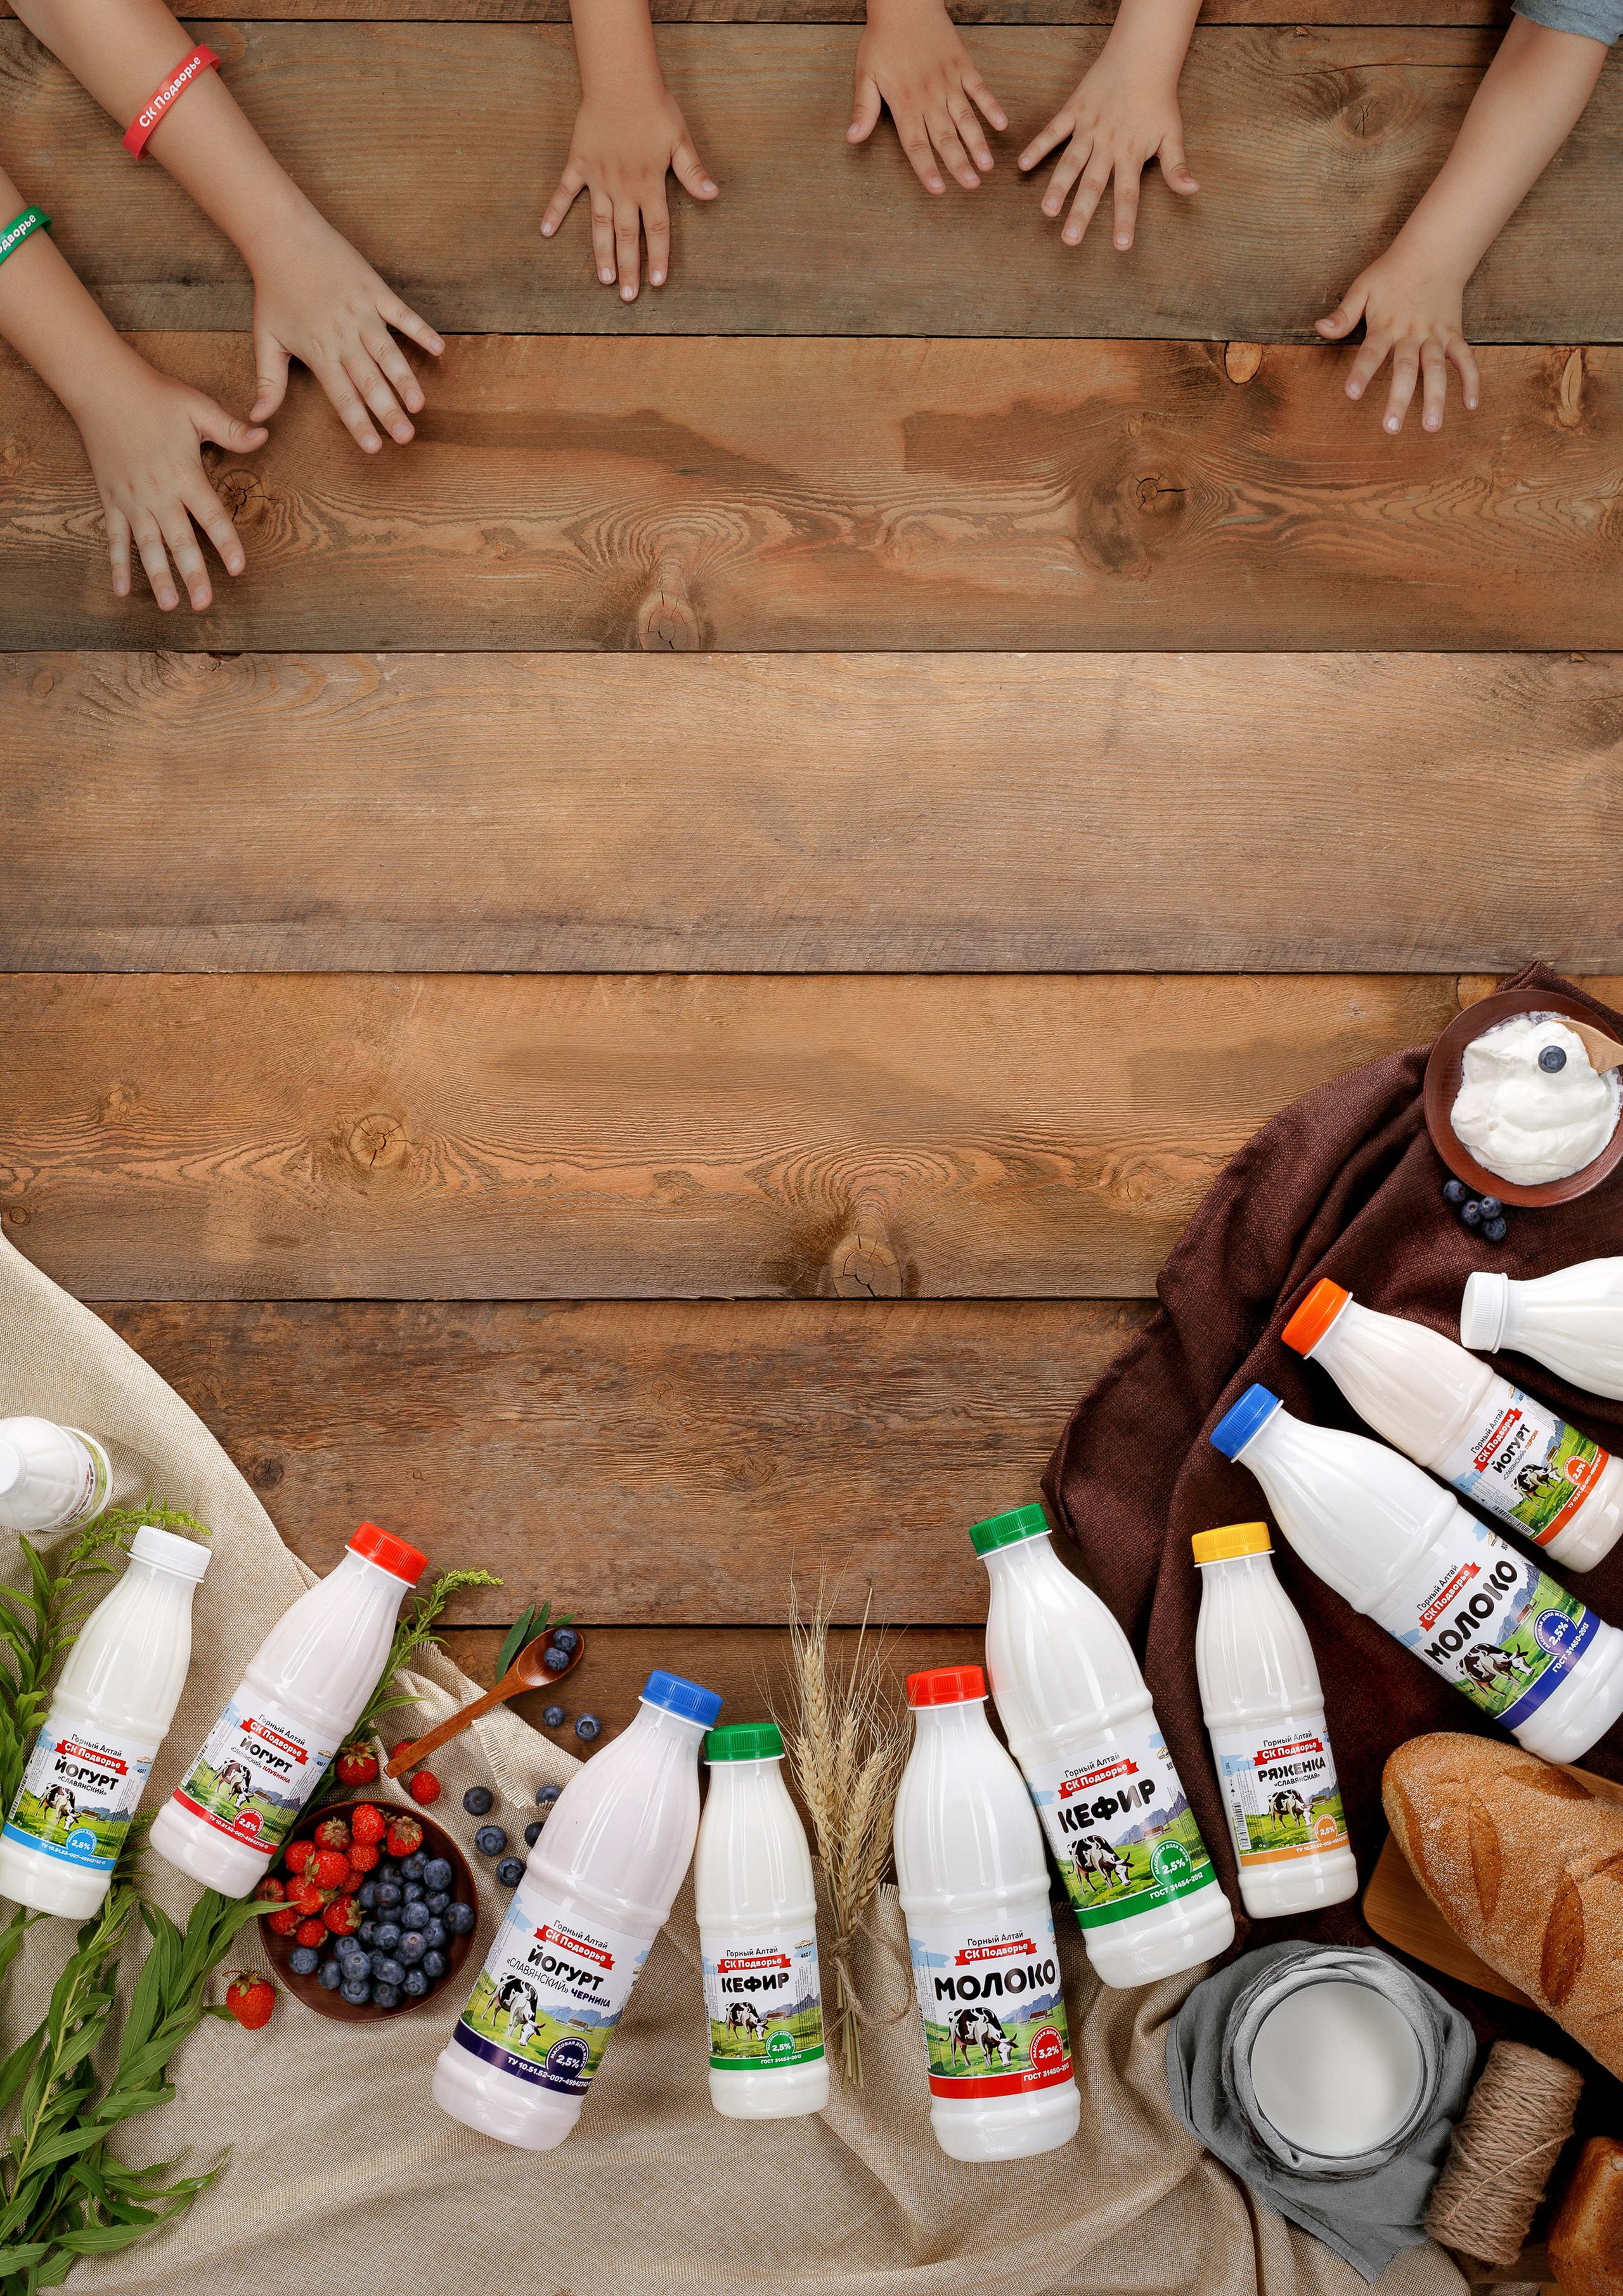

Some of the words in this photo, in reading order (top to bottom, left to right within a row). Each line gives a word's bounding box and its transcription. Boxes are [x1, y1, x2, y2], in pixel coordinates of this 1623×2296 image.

[139, 107, 157, 127] СК
[154, 57, 200, 109] Подворье
[1471, 1428, 1492, 1453] Горный
[1490, 1410, 1504, 1429] Алтай
[1478, 1448, 1490, 1463] СК
[1487, 1414, 1515, 1451] Подворье
[1525, 1429, 1539, 1450] ПЕРСИК
[1491, 1424, 1530, 1474] ЙОГУРТ
[1572, 1462, 1586, 1480] 2,5%
[1416, 1585, 1441, 1612] Горный
[1439, 1565, 1458, 1586] Алтай
[1423, 1606, 1438, 1621] СК
[1434, 1569, 1470, 1612] Подворье
[1424, 1560, 1518, 1664] МОЛОКО
[1541, 1612, 1554, 1621] ДОЛЯ
[1554, 1612, 1569, 1622] ЖИРА
[1538, 1618, 1551, 1649] МАССОВАЯ
[1549, 1621, 1568, 1646] 2,5%
[1552, 1654, 1568, 1673] ГОСТ
[1565, 1622, 1589, 1657] 31450-2013
[250, 1722, 262, 1734] СК
[262, 1729, 302, 1757] Подворье
[258, 1714, 284, 1733] Горный
[284, 1728, 306, 1745] Алтай
[1264, 1735, 1291, 1747] Горный
[1294, 1731, 1312, 1741] Алтай
[65, 1742, 77, 1754] СК
[78, 1748, 120, 1768] Подворье
[72, 1734, 98, 1750] Горный
[100, 1744, 122, 1757] Алтай
[240, 1735, 293, 1772] ЙОГУРТ
[1262, 1751, 1275, 1760] СК
[1277, 1742, 1317, 1756] Подворье
[55, 1756, 119, 1790] ЙОГУРТ
[231, 1747, 261, 1768] «СЛАВЯНСКИЙ»
[262, 1766, 290, 1784] КЛУБНИКА
[1064, 1762, 1095, 1778] Горный
[1097, 1753, 1120, 1767] Алтай
[1065, 1780, 1080, 1791] СК
[1081, 1764, 1128, 1786] Подворье
[1257, 1757, 1326, 1782] РЯЖЕНКА
[58, 1775, 107, 1796] «СЛАВЯНСКИЙ»
[1274, 1773, 1320, 1787] «СЛАВЯНСКАЯ»
[1057, 1779, 1155, 1833] КЕФИР
[238, 1818, 257, 1832] 2,5%
[1320, 1826, 1335, 1836] 2,5%
[70, 1839, 90, 1851] 2,5%
[1156, 1847, 1165, 1874] МАССОВАЯ
[1178, 1847, 1189, 1862] ЖИРА
[1161, 1859, 1186, 1874] 2,5%
[1150, 1888, 1169, 1900] ГОСТ
[1170, 1872, 1204, 1891] 31454-2012
[545, 1929, 559, 1943] СК
[560, 1936, 606, 1962] Подворье
[553, 1920, 583, 1939] Горный
[583, 1934, 607, 1949] Алтай
[967, 1935, 999, 1947] Горный
[1001, 1930, 1023, 1942] Алтай
[725, 1960, 737, 1968] СК
[739, 1958, 782, 1969] Подворье
[727, 1950, 753, 1958] Горный
[756, 1947, 778, 1955] Алтай
[965, 1950, 980, 1960] СК
[982, 1943, 1028, 1957] Подворье
[527, 1945, 604, 1991] ЙОГУРТ
[934, 1959, 1056, 2001] МОЛОКО
[507, 1957, 569, 1994] «СЛАВЯНСКИЙ»
[571, 1988, 610, 2007] ЧЕРНИКА
[721, 1973, 789, 1993] КЕФИР
[550, 2041, 576, 2059] МАССОВАЯ
[575, 2040, 586, 2052] ДОЛЯ
[772, 2042, 791, 2052] 2,5%
[1033, 2032, 1045, 2058] МАССОВАЯ
[1038, 2045, 1059, 2059] 3,2%
[508, 2056, 518, 2066] ТУ
[556, 2054, 580, 2068] 2,5%
[1024, 2072, 1041, 2081] ГОСТ
[1043, 2062, 1069, 2077] 31450-2013
